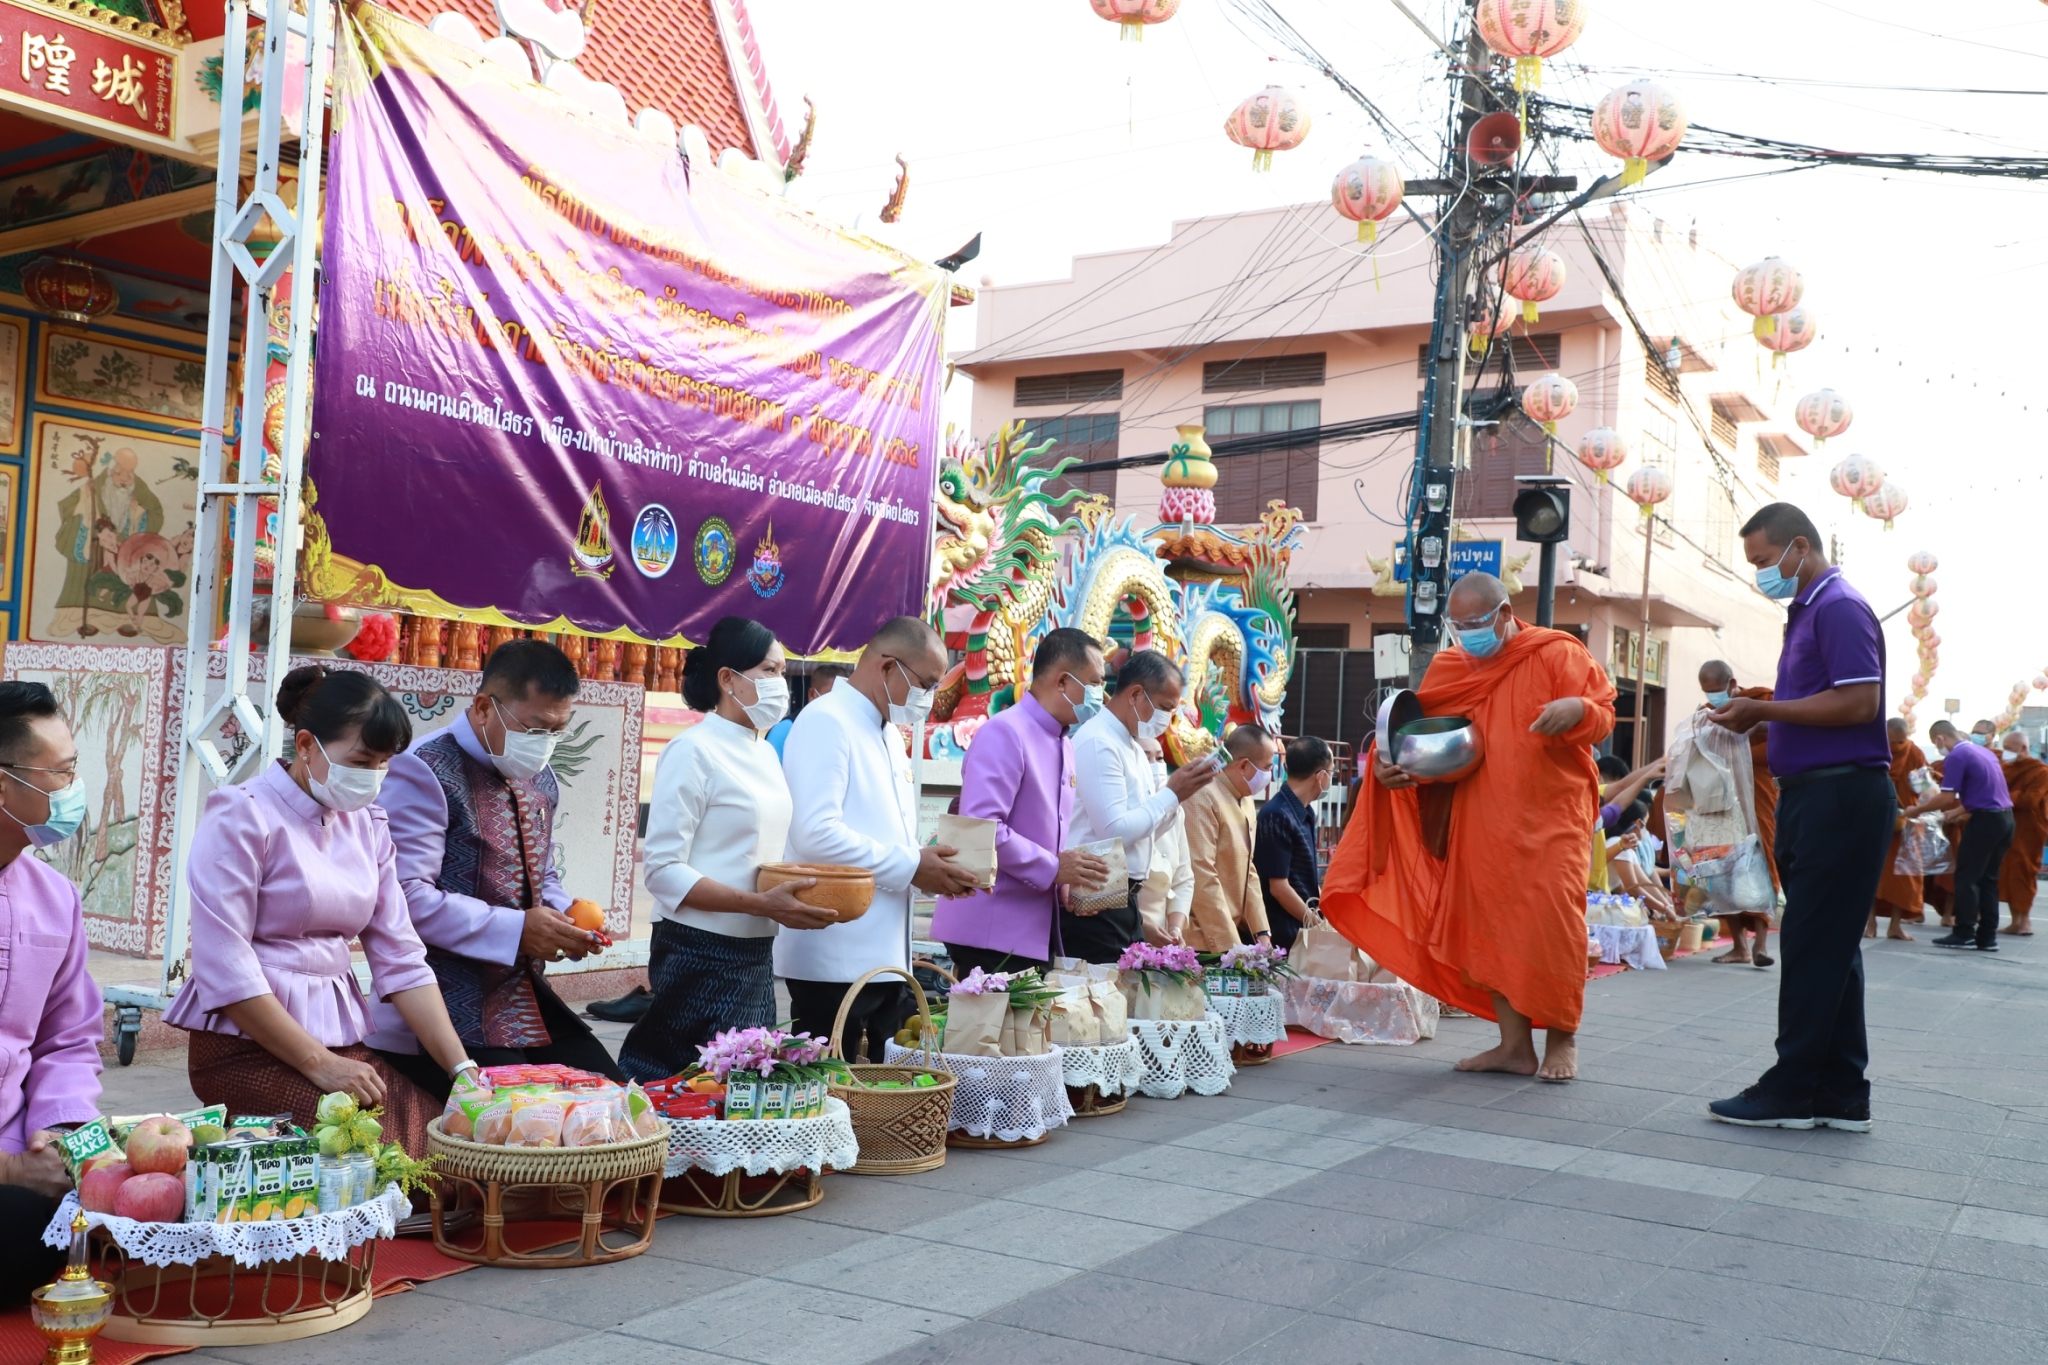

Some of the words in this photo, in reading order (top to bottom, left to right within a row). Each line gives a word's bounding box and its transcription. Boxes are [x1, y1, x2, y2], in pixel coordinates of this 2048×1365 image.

[355, 373, 377, 399] ณ
[384, 380, 534, 438] ถนนคนเดินยโสธร
[541, 415, 684, 478] (เมืองเก่าบ้านสิงห์ท่า)
[688, 455, 764, 493] ตำบลในเมือง
[768, 472, 858, 514] อำเภอเมืองยโสธร
[863, 491, 920, 527] จังหวัดยโสธร
[66, 1125, 102, 1150] EURO
[73, 1133, 107, 1160] CAKE
[258, 1159, 281, 1170] Tipco
[291, 1155, 314, 1166] Tipco
